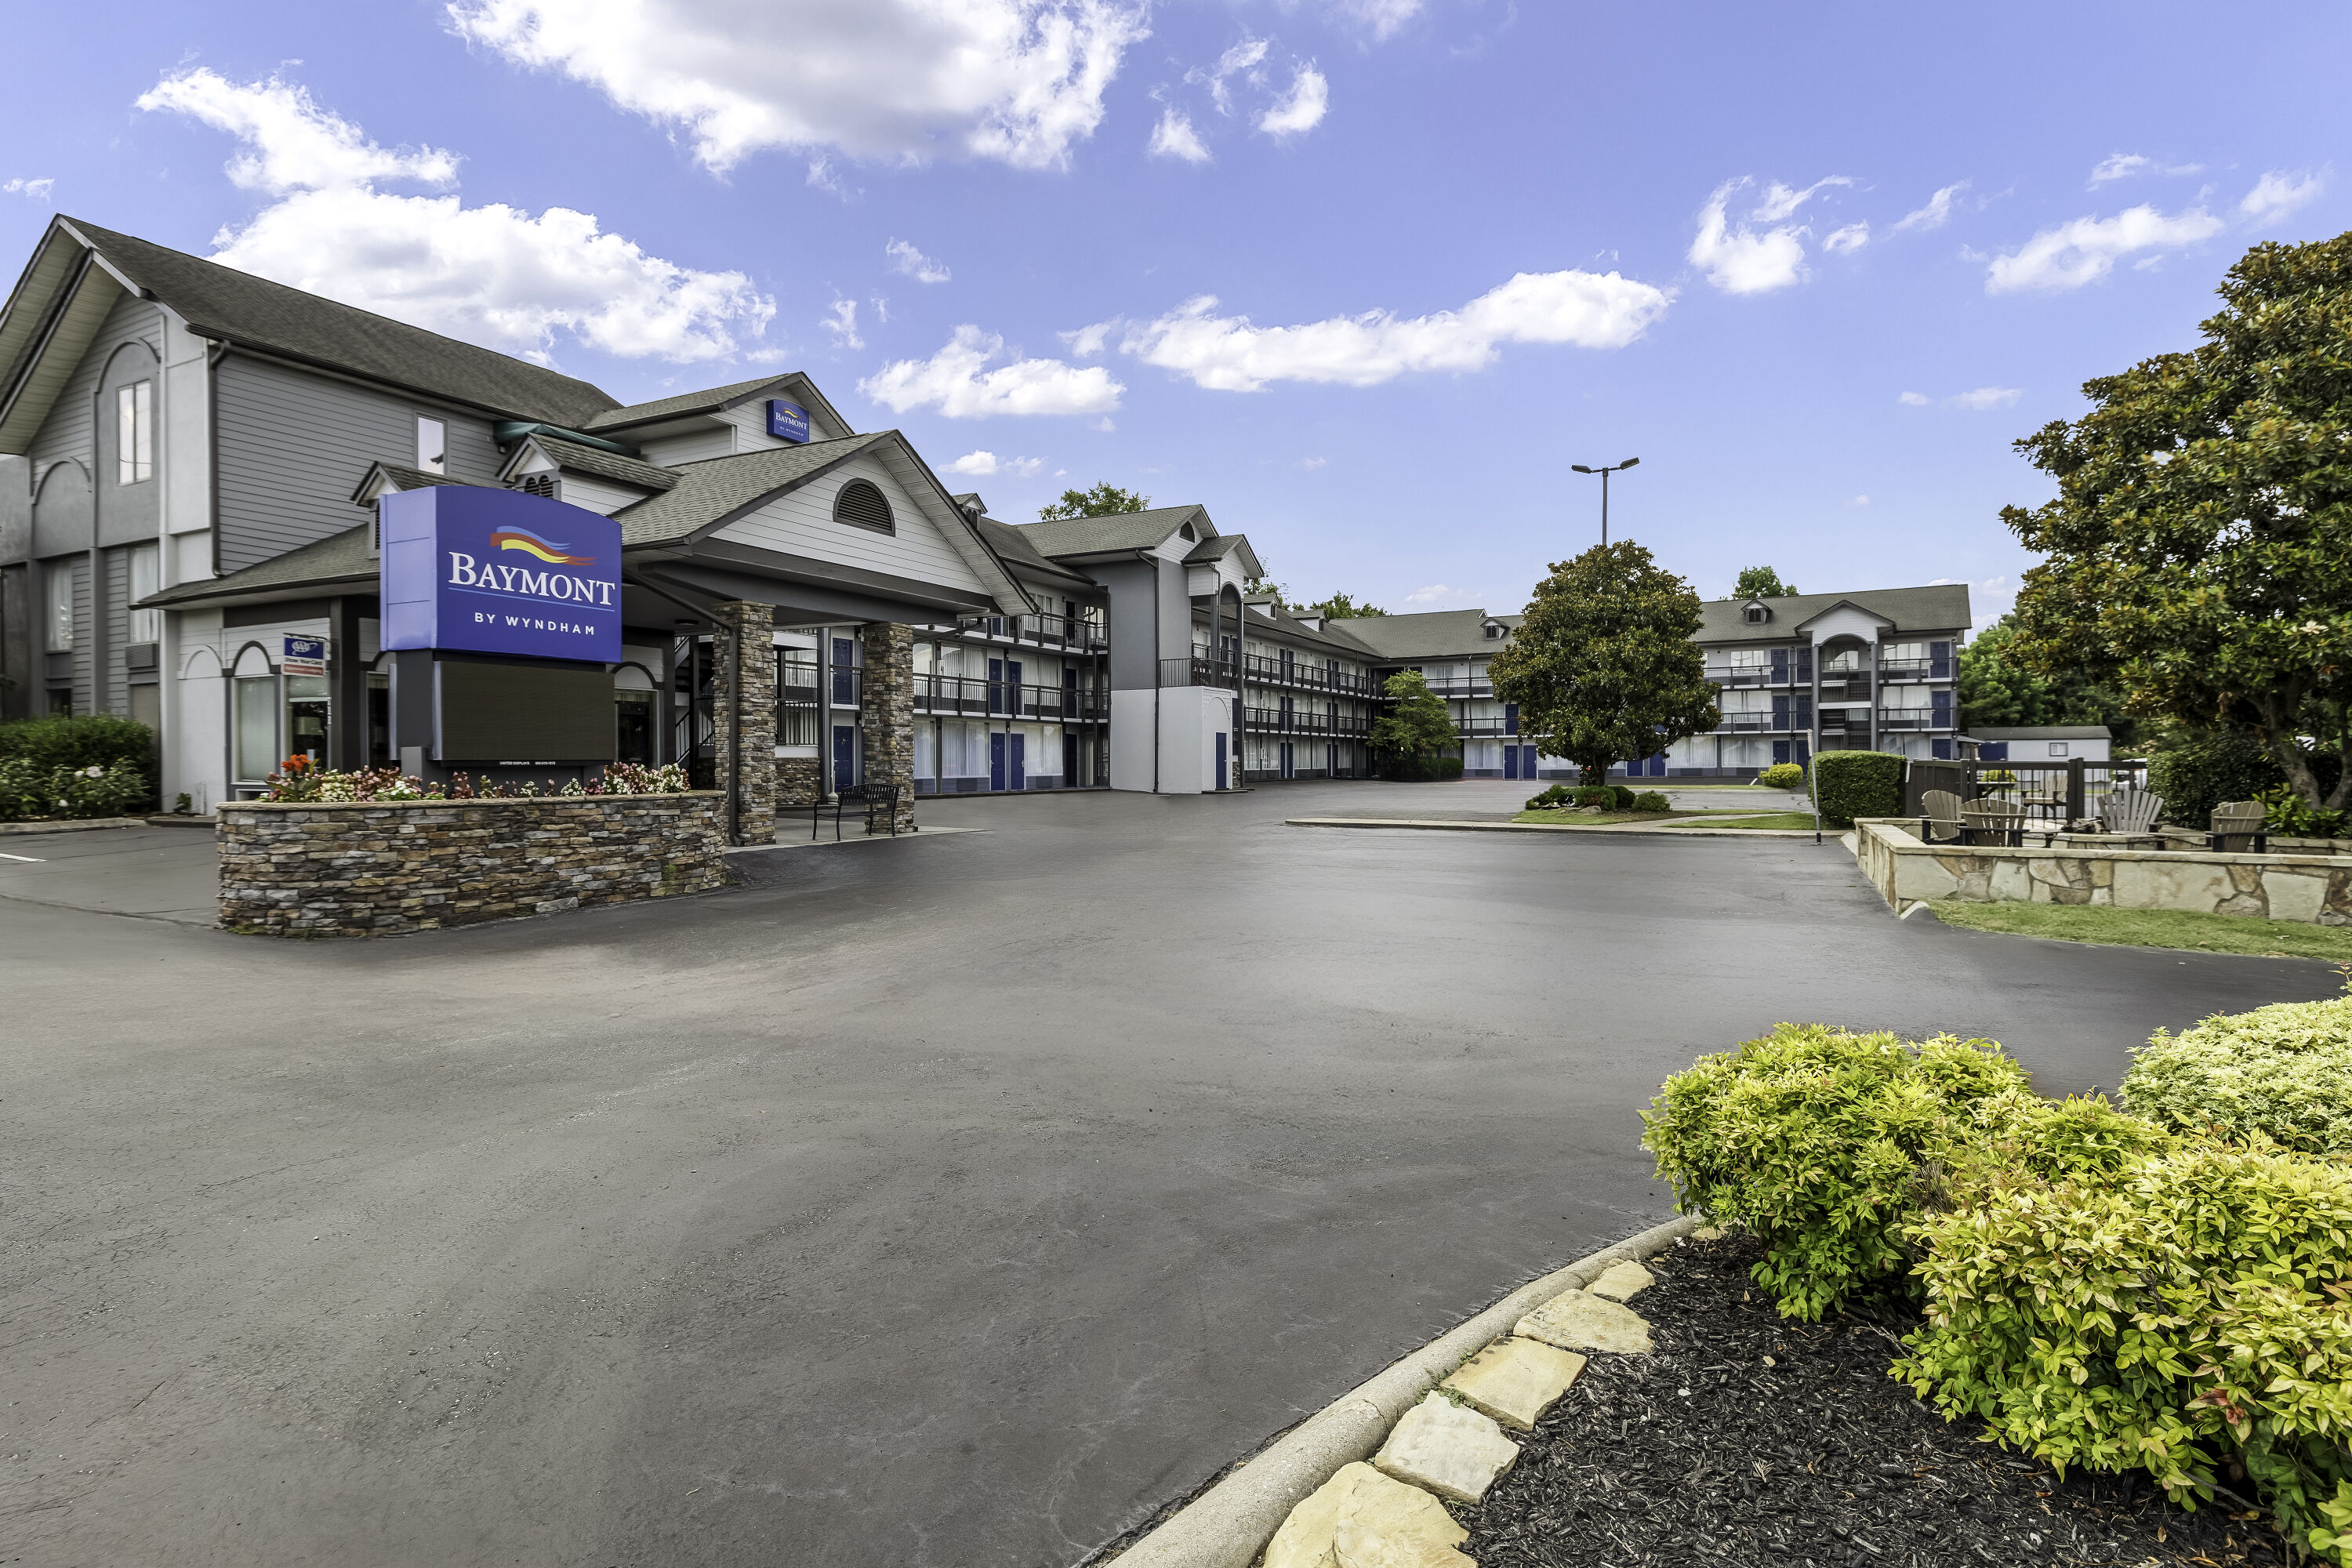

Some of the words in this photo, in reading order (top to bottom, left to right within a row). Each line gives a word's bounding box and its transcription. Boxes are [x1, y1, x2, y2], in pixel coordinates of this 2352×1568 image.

[775, 412, 808, 430] BAYMONT
[448, 551, 615, 605] BAYMONT
[474, 612, 495, 624] BY
[505, 615, 595, 636] WYNDHAM
